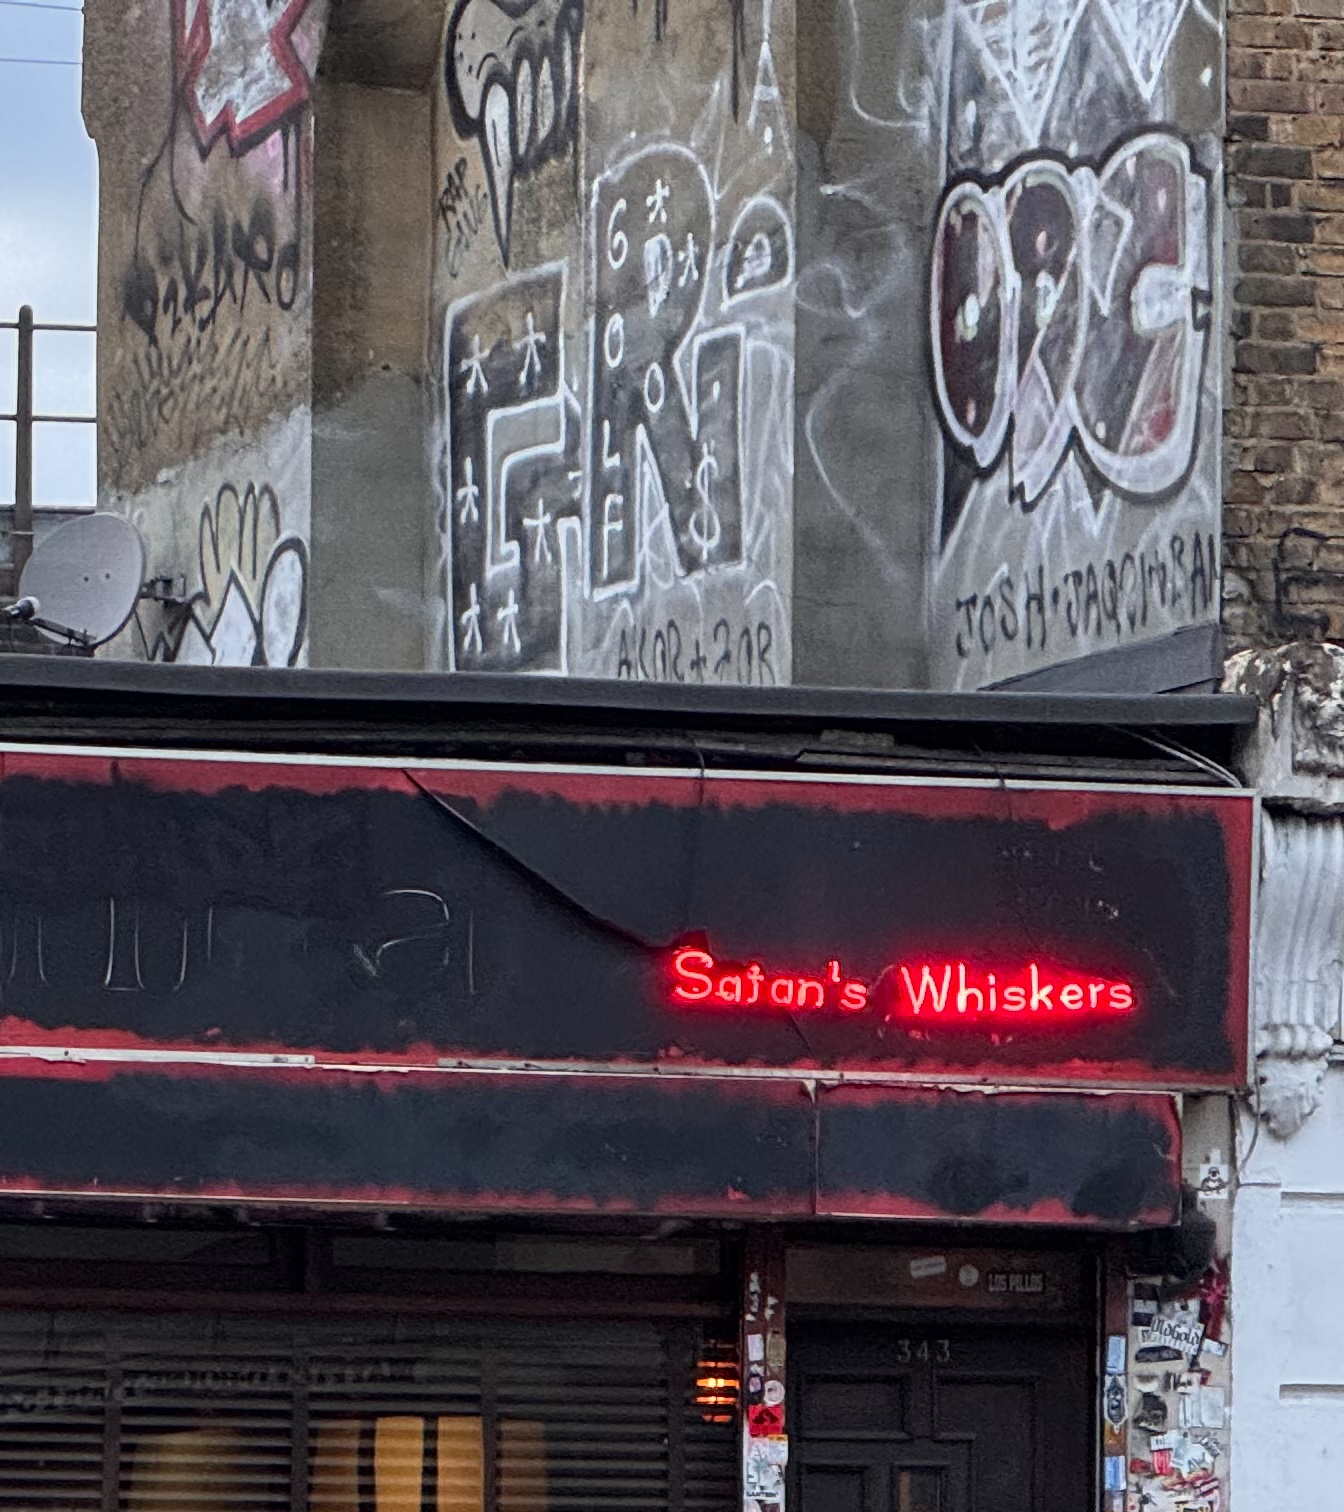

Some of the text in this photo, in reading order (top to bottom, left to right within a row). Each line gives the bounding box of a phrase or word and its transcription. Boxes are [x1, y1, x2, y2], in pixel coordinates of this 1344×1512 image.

[672, 948, 1135, 1014] Satan's Whiskers
[896, 1338, 951, 1363] 343
